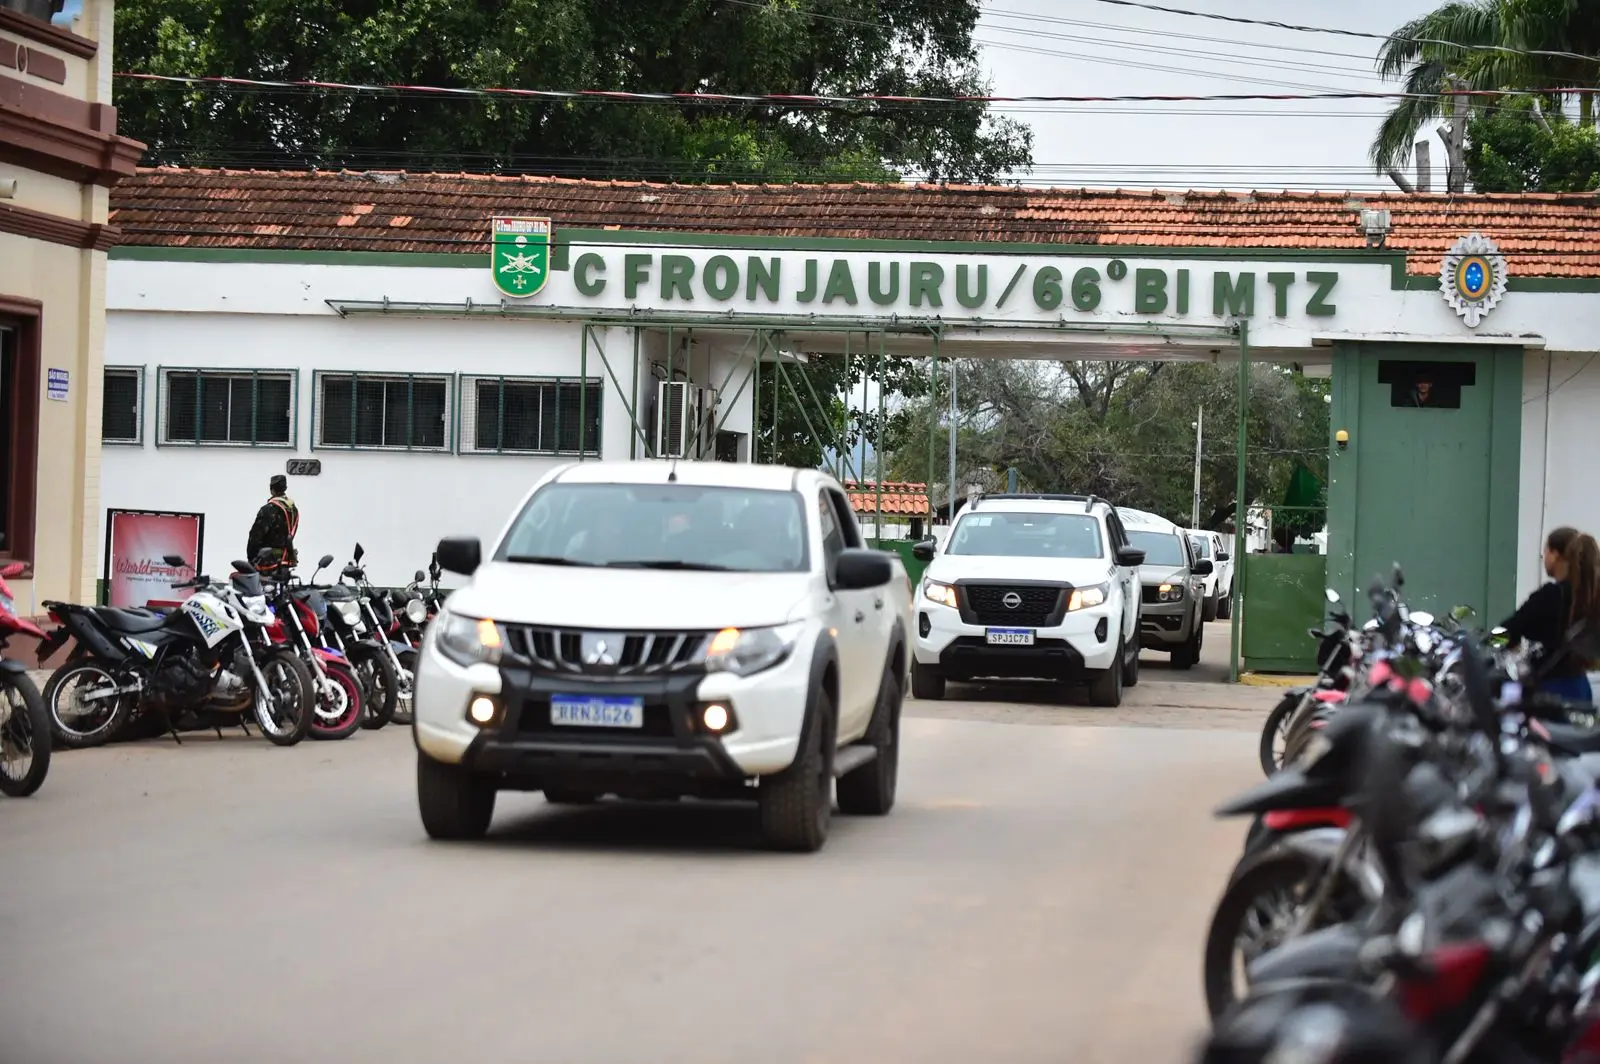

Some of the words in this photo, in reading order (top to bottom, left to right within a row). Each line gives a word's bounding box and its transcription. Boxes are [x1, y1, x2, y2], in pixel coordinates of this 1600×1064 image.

[573, 252, 606, 297] C
[625, 253, 781, 303] FRON
[1212, 270, 1339, 320] MTZ
[558, 703, 633, 724] RRN3G26
